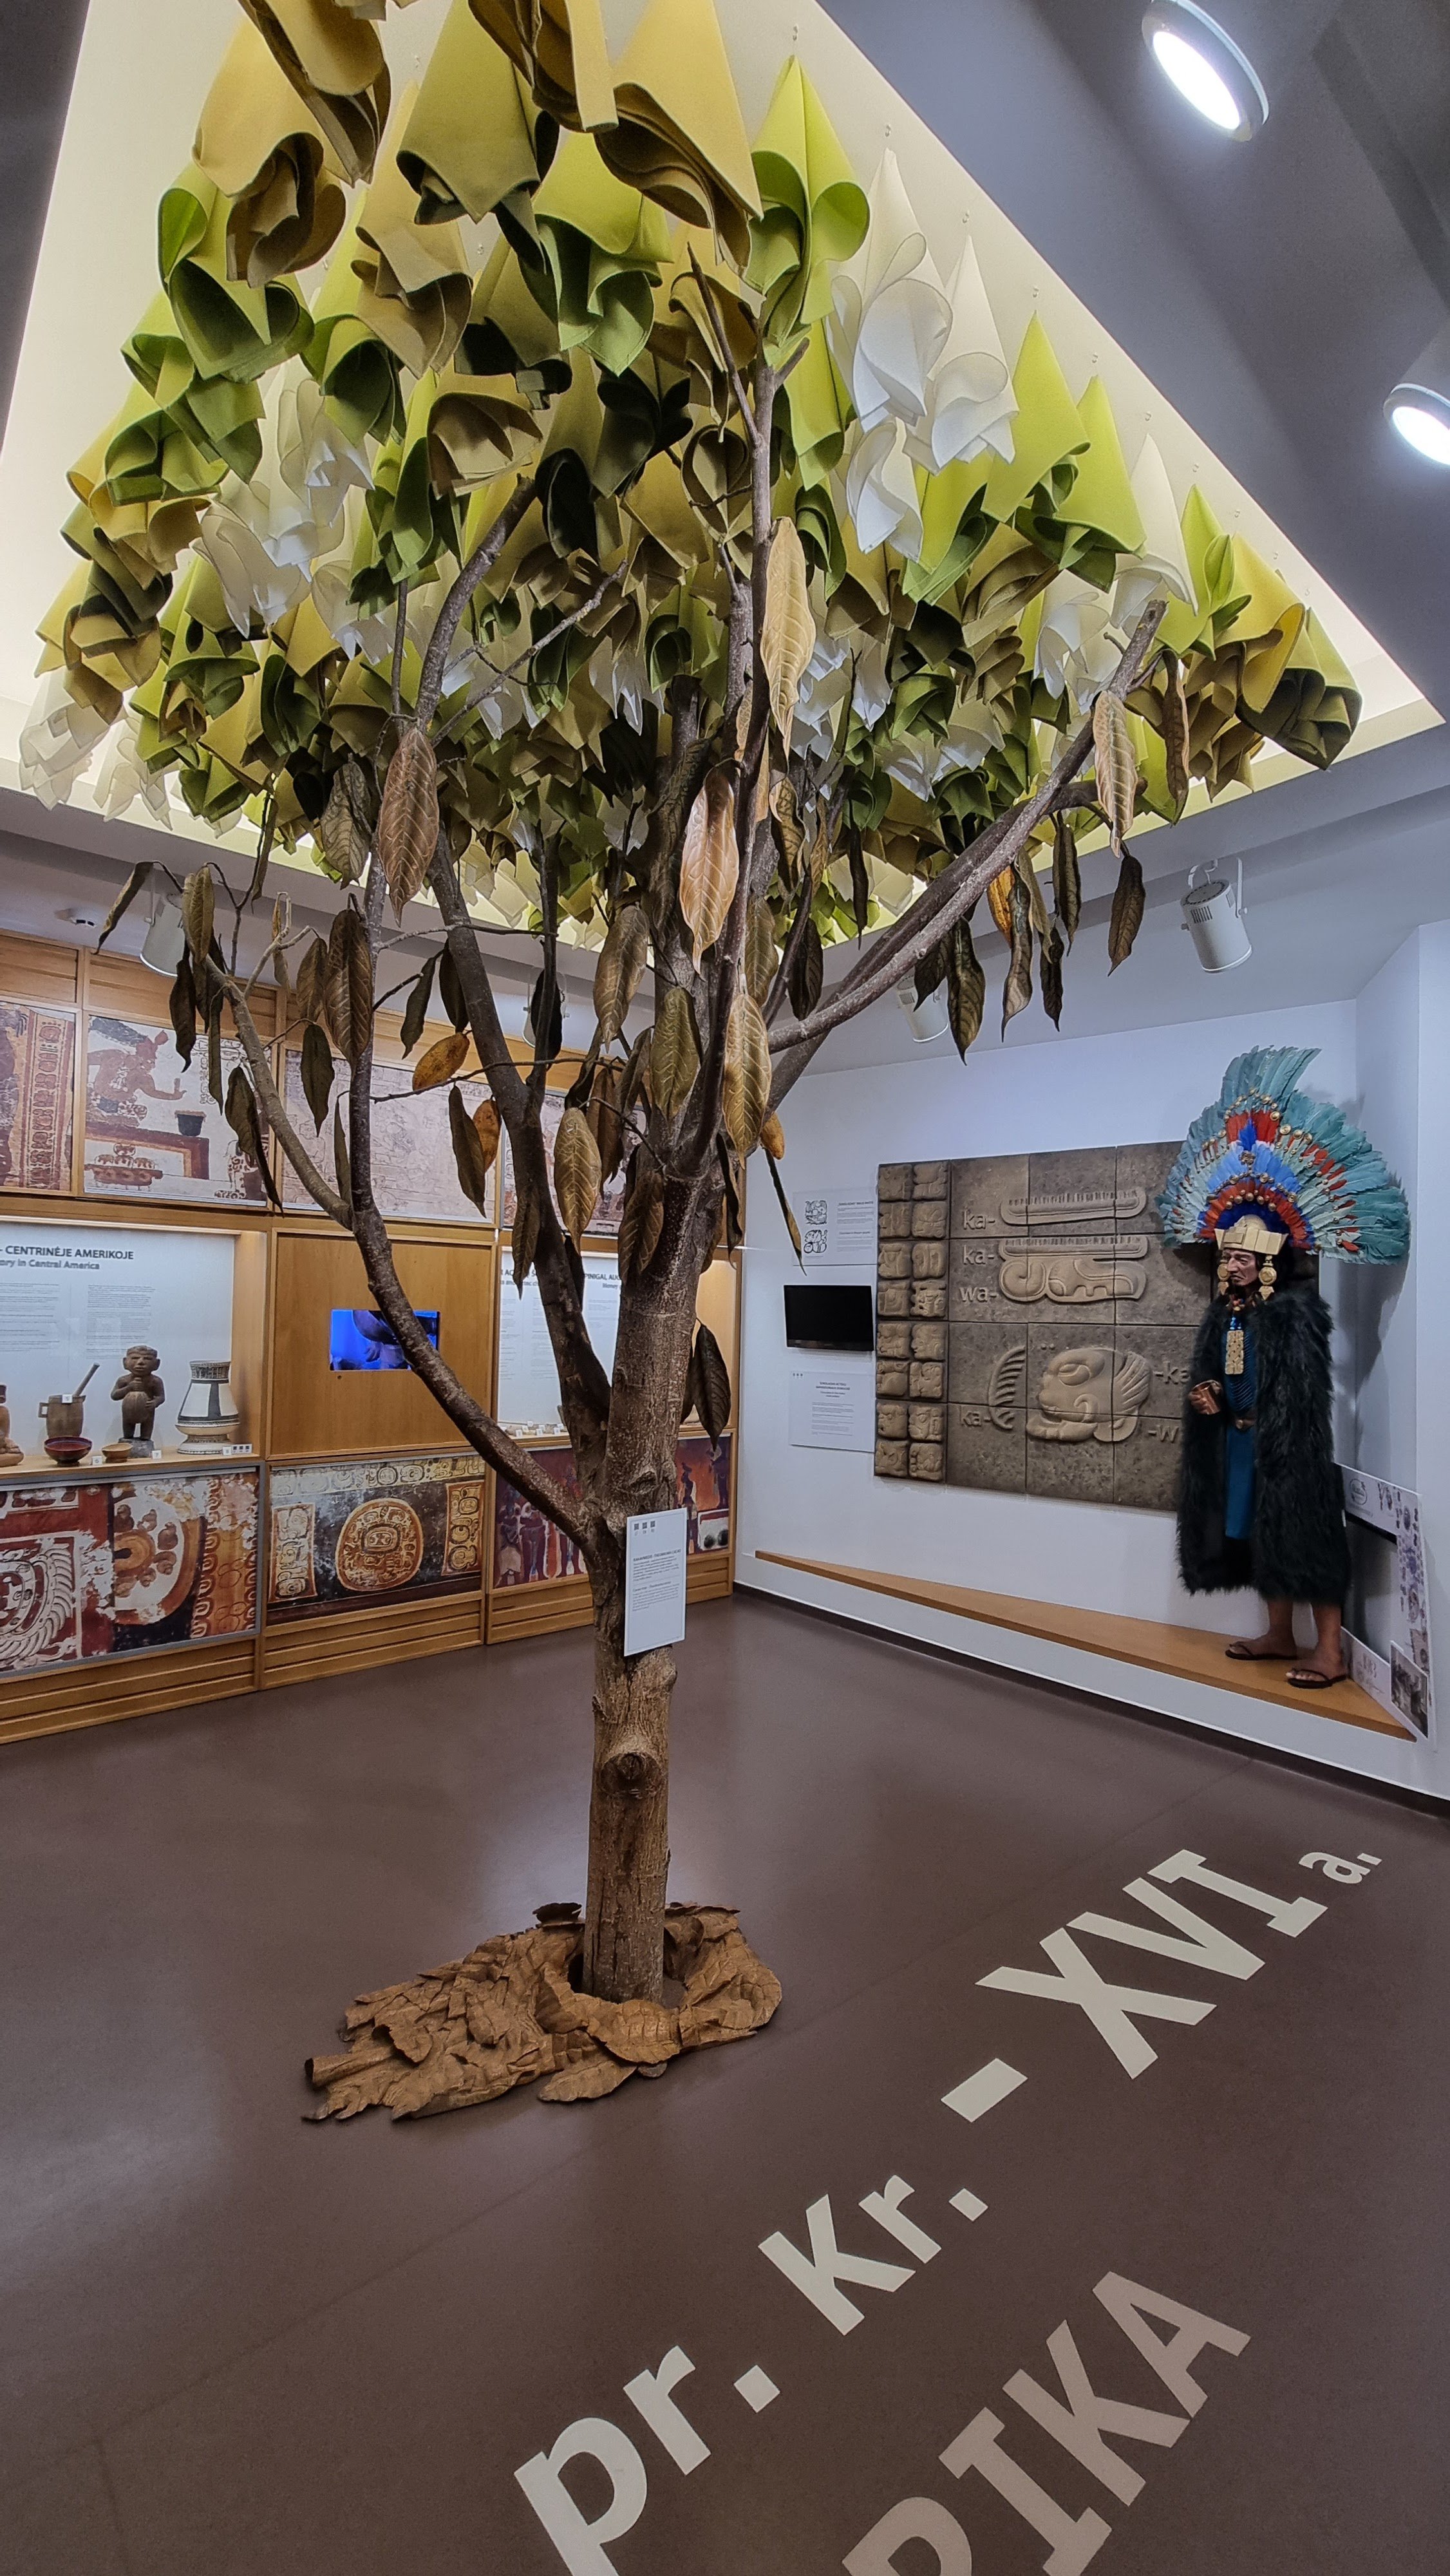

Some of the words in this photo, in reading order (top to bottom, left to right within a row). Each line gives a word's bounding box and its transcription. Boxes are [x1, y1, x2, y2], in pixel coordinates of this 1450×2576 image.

[963, 1209, 995, 1230] ka-
[5, 1244, 72, 1258] CENTRINĖJE
[74, 1248, 134, 1260] AMERIKOJE
[963, 1245, 995, 1265] ka-
[28, 1258, 62, 1268] Central
[62, 1260, 100, 1271] America
[959, 1287, 997, 1302] wa-
[960, 1405, 992, 1427] ka-
[514, 2345, 780, 2576] pr.
[758, 2175, 988, 2335] Kr.
[975, 1850, 1328, 2079] XVI
[1298, 1851, 1382, 1884] a.
